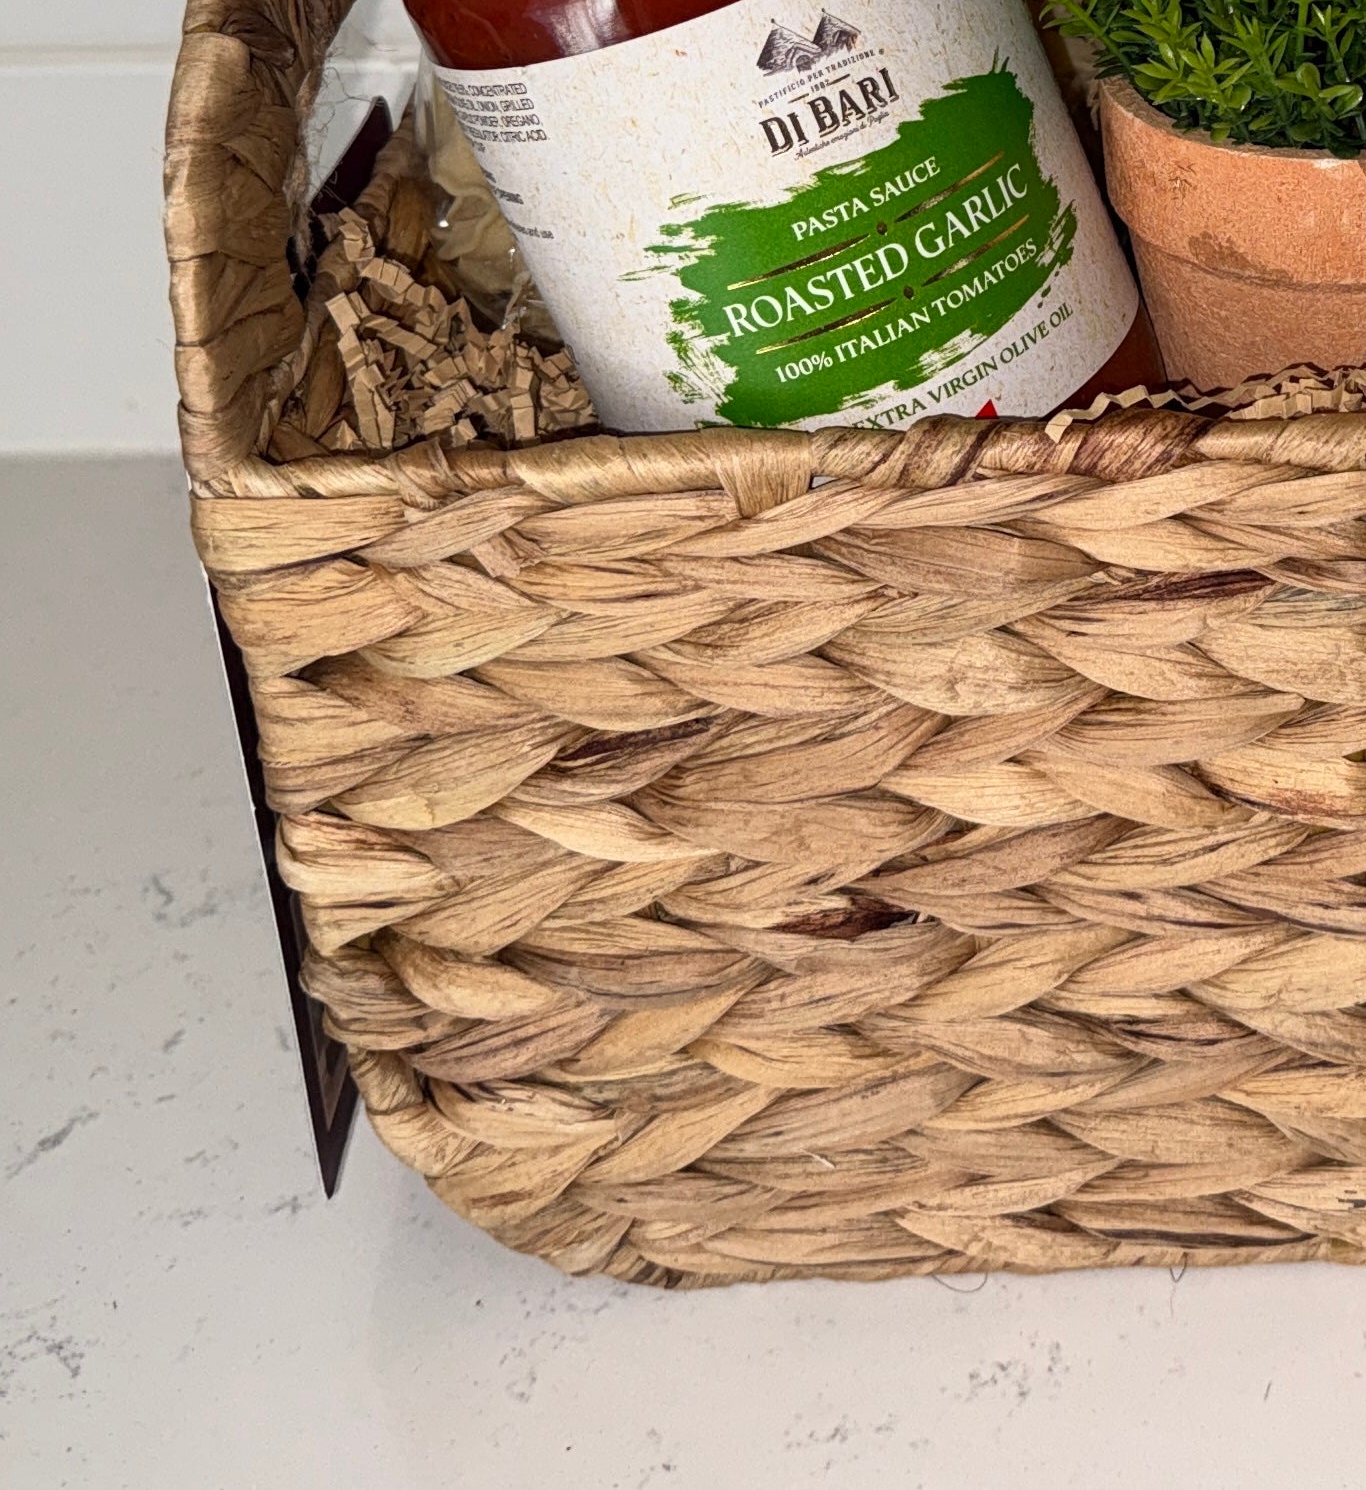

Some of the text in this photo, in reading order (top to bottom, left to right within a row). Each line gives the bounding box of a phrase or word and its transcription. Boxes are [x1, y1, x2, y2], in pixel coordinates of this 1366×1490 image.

[758, 49, 876, 109] PASTIFICIO PER TRADIZIONE
[759, 66, 901, 158] DI BARI
[791, 156, 942, 242] PASTA SAUCE
[722, 162, 1029, 339] ROASTED GARLIC
[775, 237, 1039, 384] 100% ITALIAN TOMATOES
[926, 359, 1000, 404] VIRGIN
[998, 321, 1051, 365] OLIVE
[1048, 302, 1075, 338] OIL
